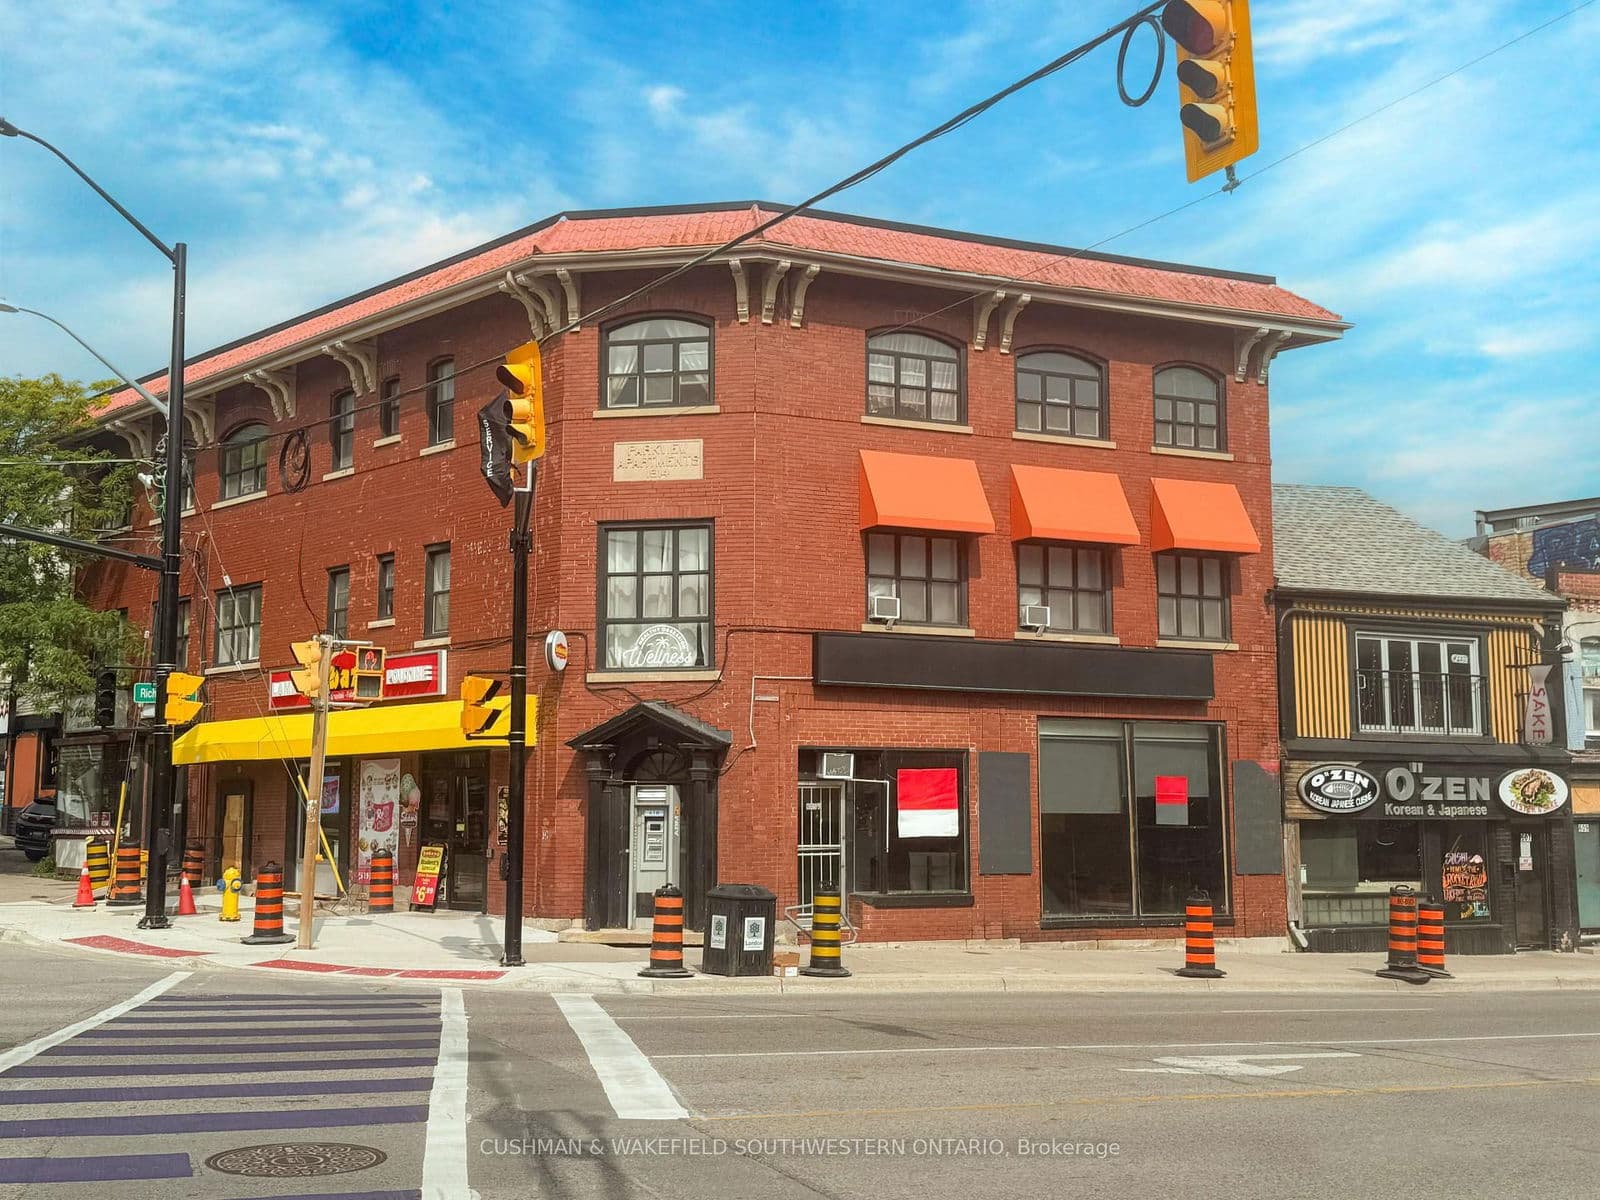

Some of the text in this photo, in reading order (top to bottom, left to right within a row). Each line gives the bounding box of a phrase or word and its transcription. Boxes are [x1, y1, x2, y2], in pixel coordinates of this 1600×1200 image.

[483, 420, 493, 477] SERVICE
[622, 645, 692, 667] Wellness
[140, 686, 156, 699] Rich
[1532, 687, 1546, 740] SAKE
[1310, 791, 1330, 807] KOREAN
[1385, 803, 1488, 818] Korean & Japanese
